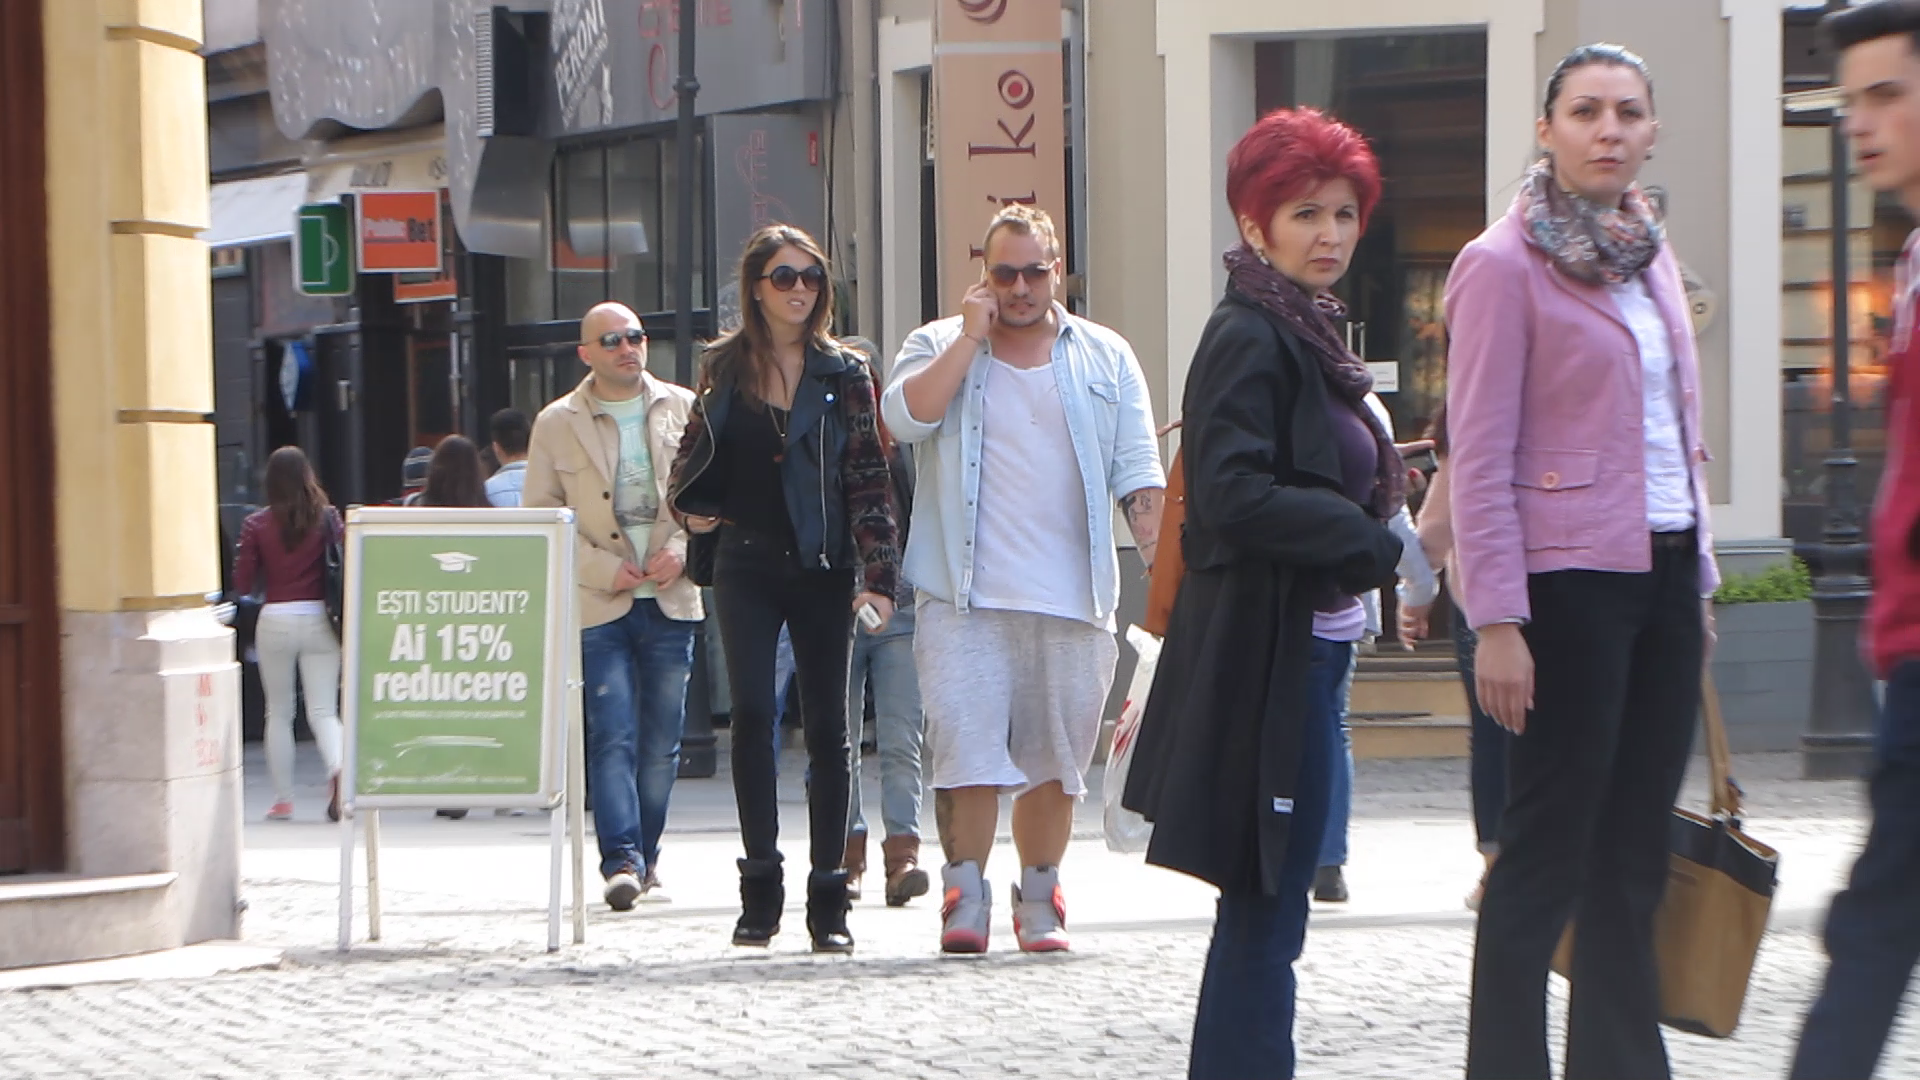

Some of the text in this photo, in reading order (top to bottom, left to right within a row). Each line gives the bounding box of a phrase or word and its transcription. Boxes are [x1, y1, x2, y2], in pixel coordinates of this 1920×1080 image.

[426, 589, 530, 615] STUDENT?
[389, 623, 514, 662] Ai 15%
[373, 663, 529, 703] reducere
